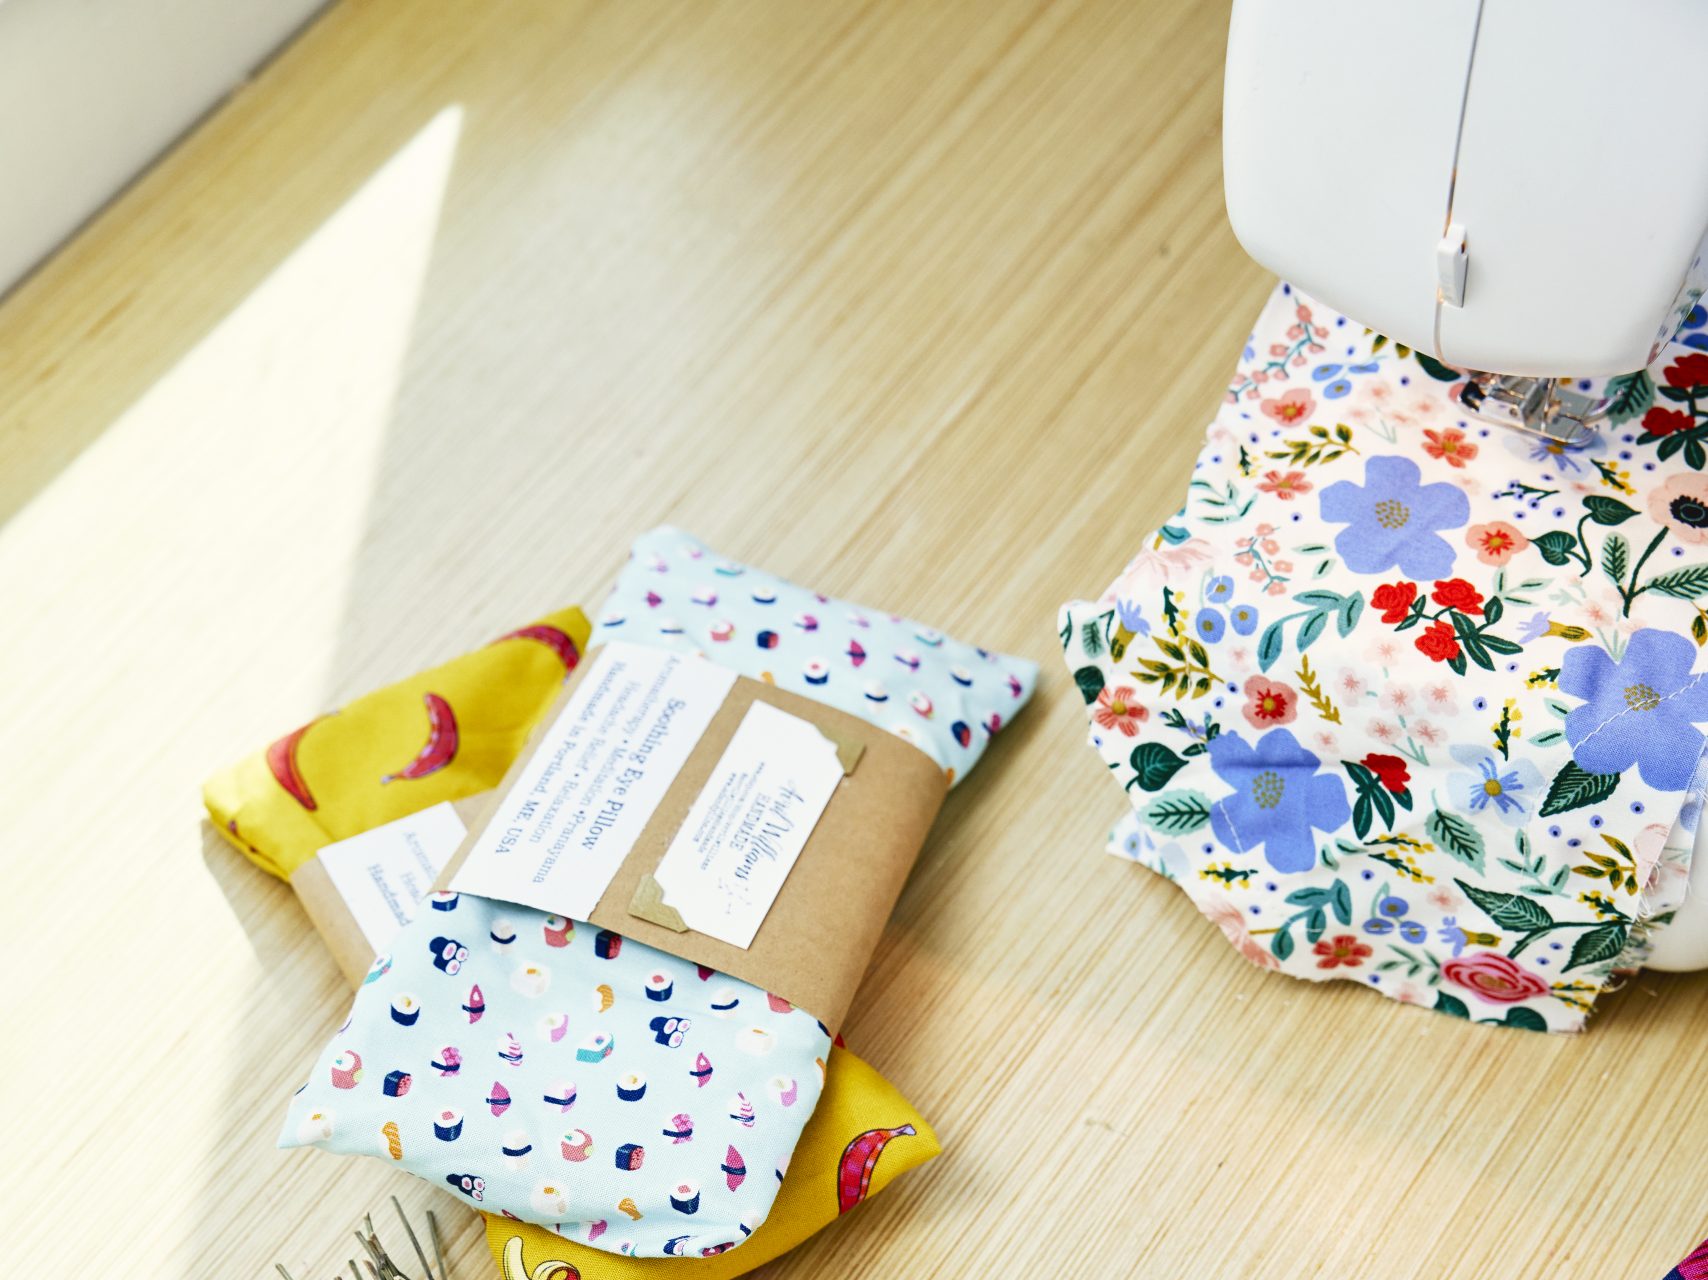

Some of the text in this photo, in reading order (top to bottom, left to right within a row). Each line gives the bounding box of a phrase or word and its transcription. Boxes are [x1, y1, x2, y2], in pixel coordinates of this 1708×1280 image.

[580, 660, 627, 723] Handmade
[569, 724, 586, 738] in
[576, 736, 606, 771] Relief
[578, 746, 626, 807] Meditation
[582, 697, 686, 850] Soothing Eye Pillow
[495, 826, 523, 855] USA
[529, 779, 578, 843] Relaxation
[729, 792, 771, 851] HANDMADE
[734, 821, 790, 880] Williams
